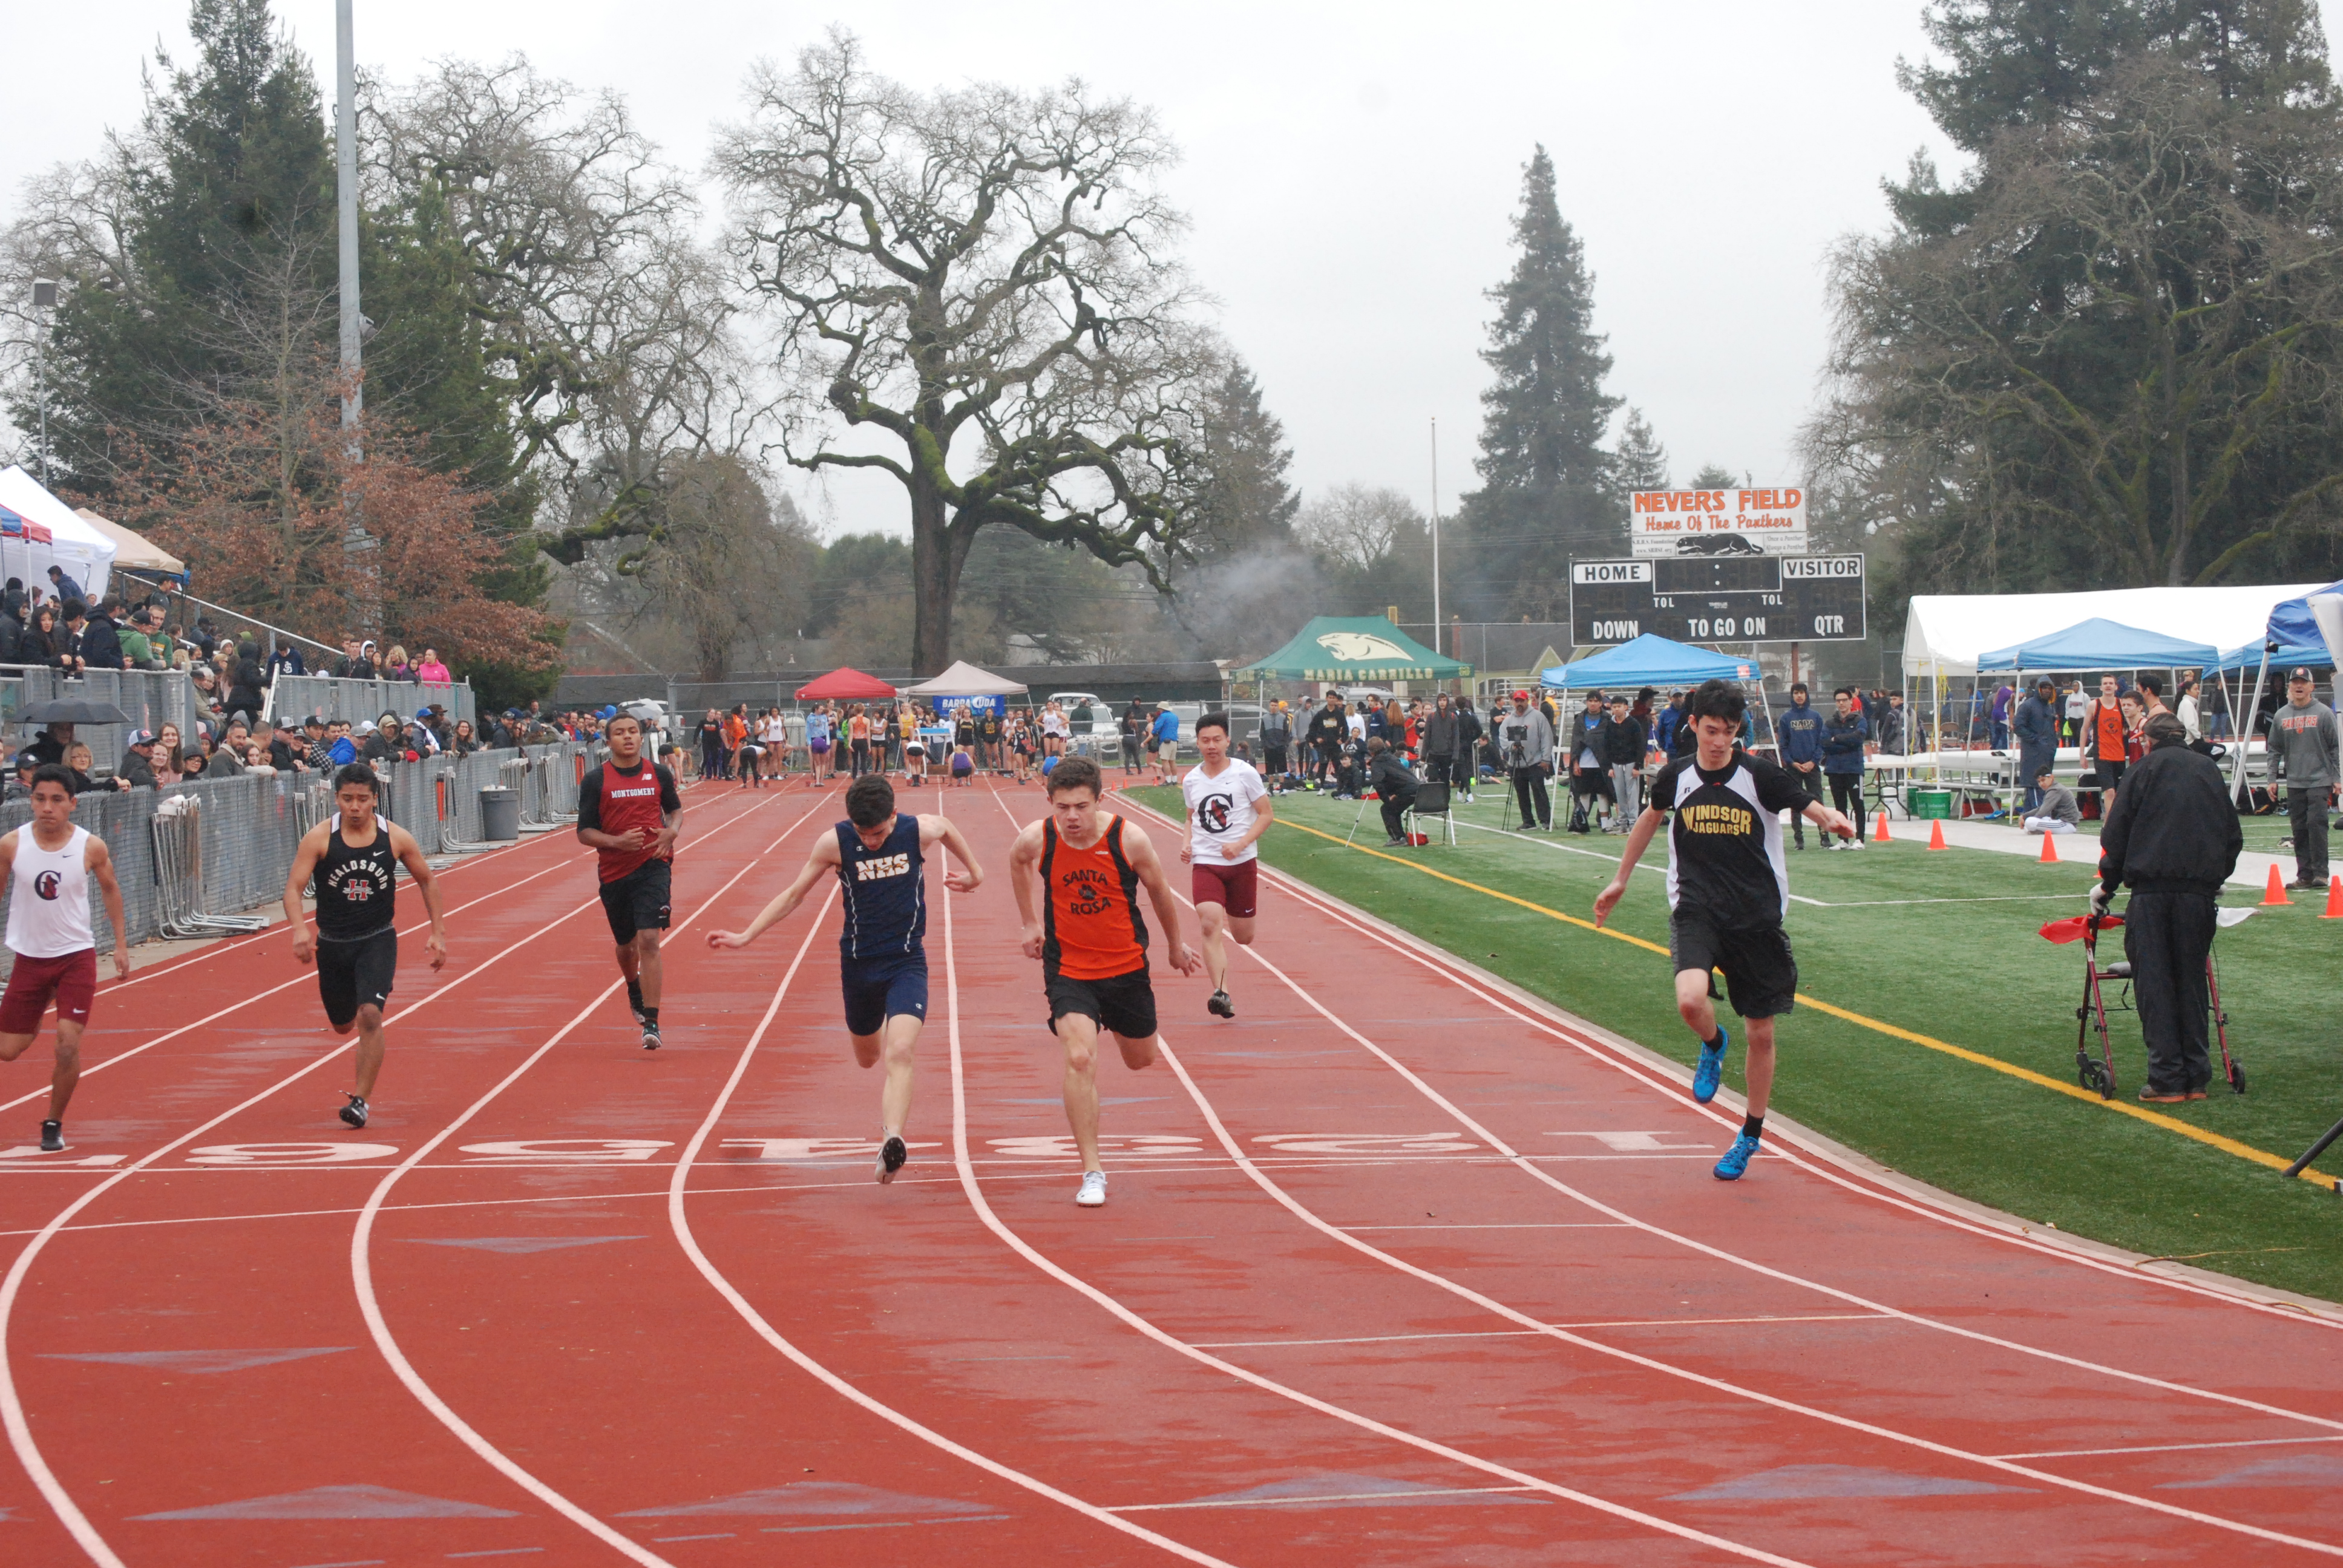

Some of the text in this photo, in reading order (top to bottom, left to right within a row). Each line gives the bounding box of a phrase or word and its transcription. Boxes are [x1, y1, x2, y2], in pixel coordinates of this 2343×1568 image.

[1634, 489, 1801, 513] NEVERS FIELD
[1646, 513, 1792, 532] Home Of The Panthers
[1585, 566, 1640, 581] HOME
[1786, 560, 1858, 575] VISITOR
[1654, 597, 1674, 607] TOL
[1761, 595, 1783, 605] TOL
[1593, 620, 1639, 639] DOWN
[1688, 617, 1766, 636] TO GO ON
[1815, 615, 1844, 636] QTR
[1304, 667, 1434, 681] MARIA CARRILLO
[611, 788, 655, 799] MONTGOMERY
[1682, 805, 1752, 835] WINDSOR
[1693, 822, 1740, 835] JAGUARS
[856, 852, 909, 881] NHS
[1063, 869, 1108, 887] SANTA
[1070, 897, 1112, 915] ROSA
